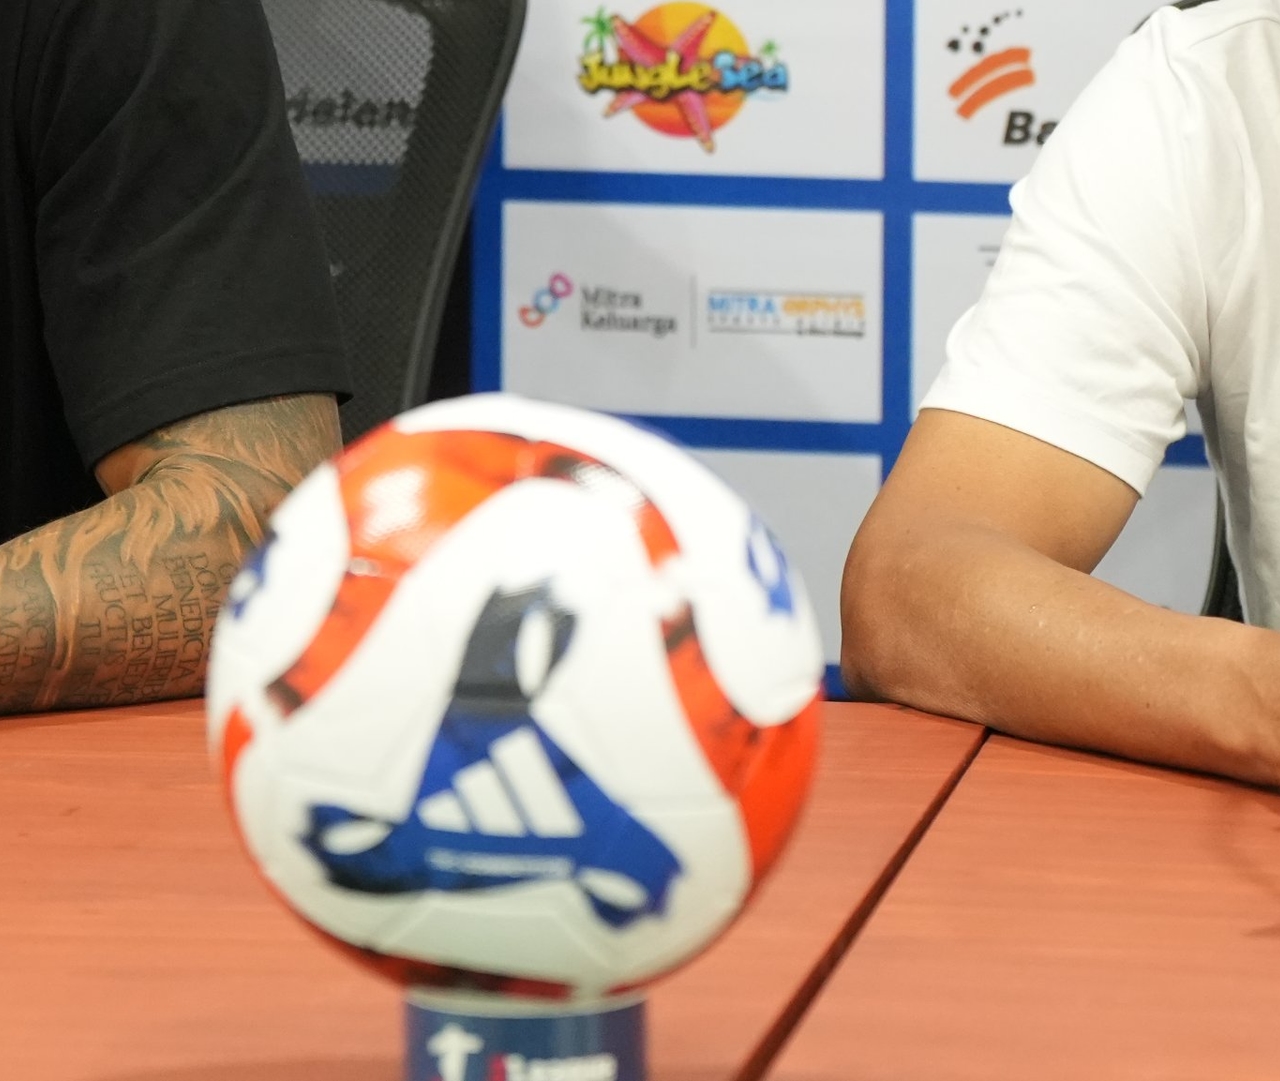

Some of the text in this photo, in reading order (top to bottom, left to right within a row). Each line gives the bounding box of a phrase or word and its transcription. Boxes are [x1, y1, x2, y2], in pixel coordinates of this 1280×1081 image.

[712, 50, 789, 95] Sea
[115, 615, 154, 704] BENEDIC
[141, 592, 180, 698] MULIERIB
